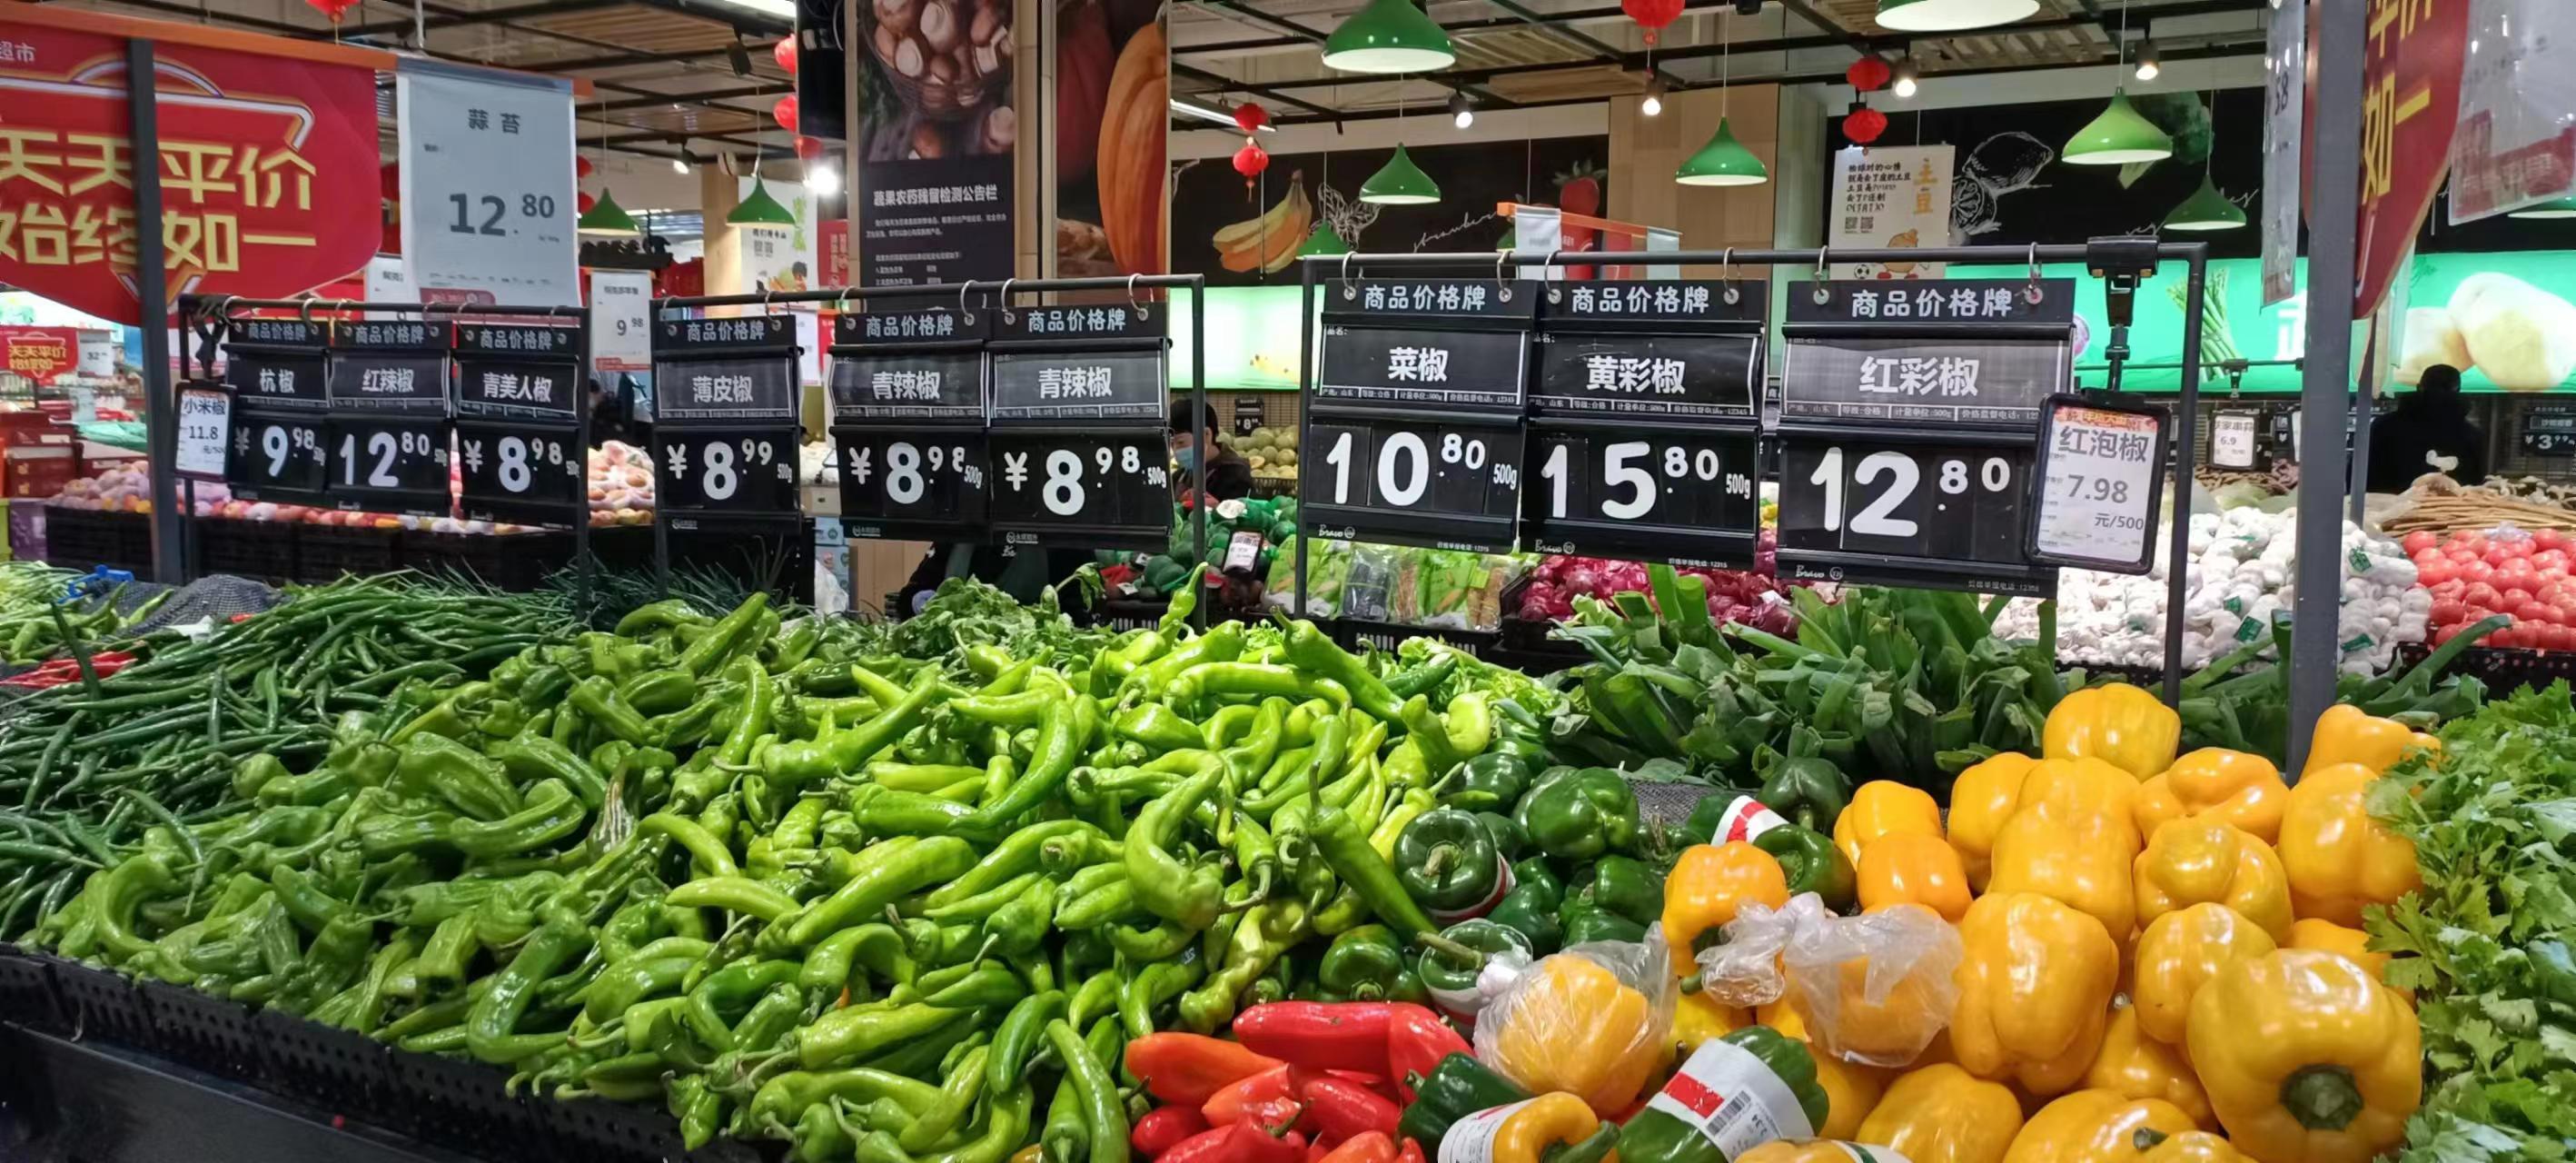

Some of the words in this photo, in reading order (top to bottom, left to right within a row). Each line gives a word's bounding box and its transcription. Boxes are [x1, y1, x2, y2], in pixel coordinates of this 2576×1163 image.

[0, 127, 316, 210] 天天平价
[0, 202, 316, 272] 始终如一
[1364, 284, 1487, 312] 商品价格牌
[1571, 286, 1711, 314] 商品价格牌
[1851, 288, 2014, 318] 商品价格牌
[687, 320, 766, 342] 商品价格牌
[866, 315, 954, 337] 商品价格牌
[1028, 309, 1127, 333] 商品价格牌
[480, 330, 553, 349] 商品价格牌
[1388, 346, 1450, 383] 菜椒
[1586, 354, 1687, 394] 黄彩椒
[1858, 356, 1981, 396] 红彩椒
[362, 368, 415, 393] 红辣椒
[483, 372, 552, 403] 青美人椒
[692, 375, 754, 404] 薄皮椒
[871, 371, 941, 400] 青辣椒
[1038, 366, 1114, 400] 青辣椒
[189, 425, 218, 440] 11.8
[2058, 425, 2149, 462] 红泡椒
[1493, 462, 1517, 491] 500g
[1726, 472, 1750, 500] 500g
[2068, 473, 2128, 503] 7.98
[2095, 512, 2145, 531] 元/500
